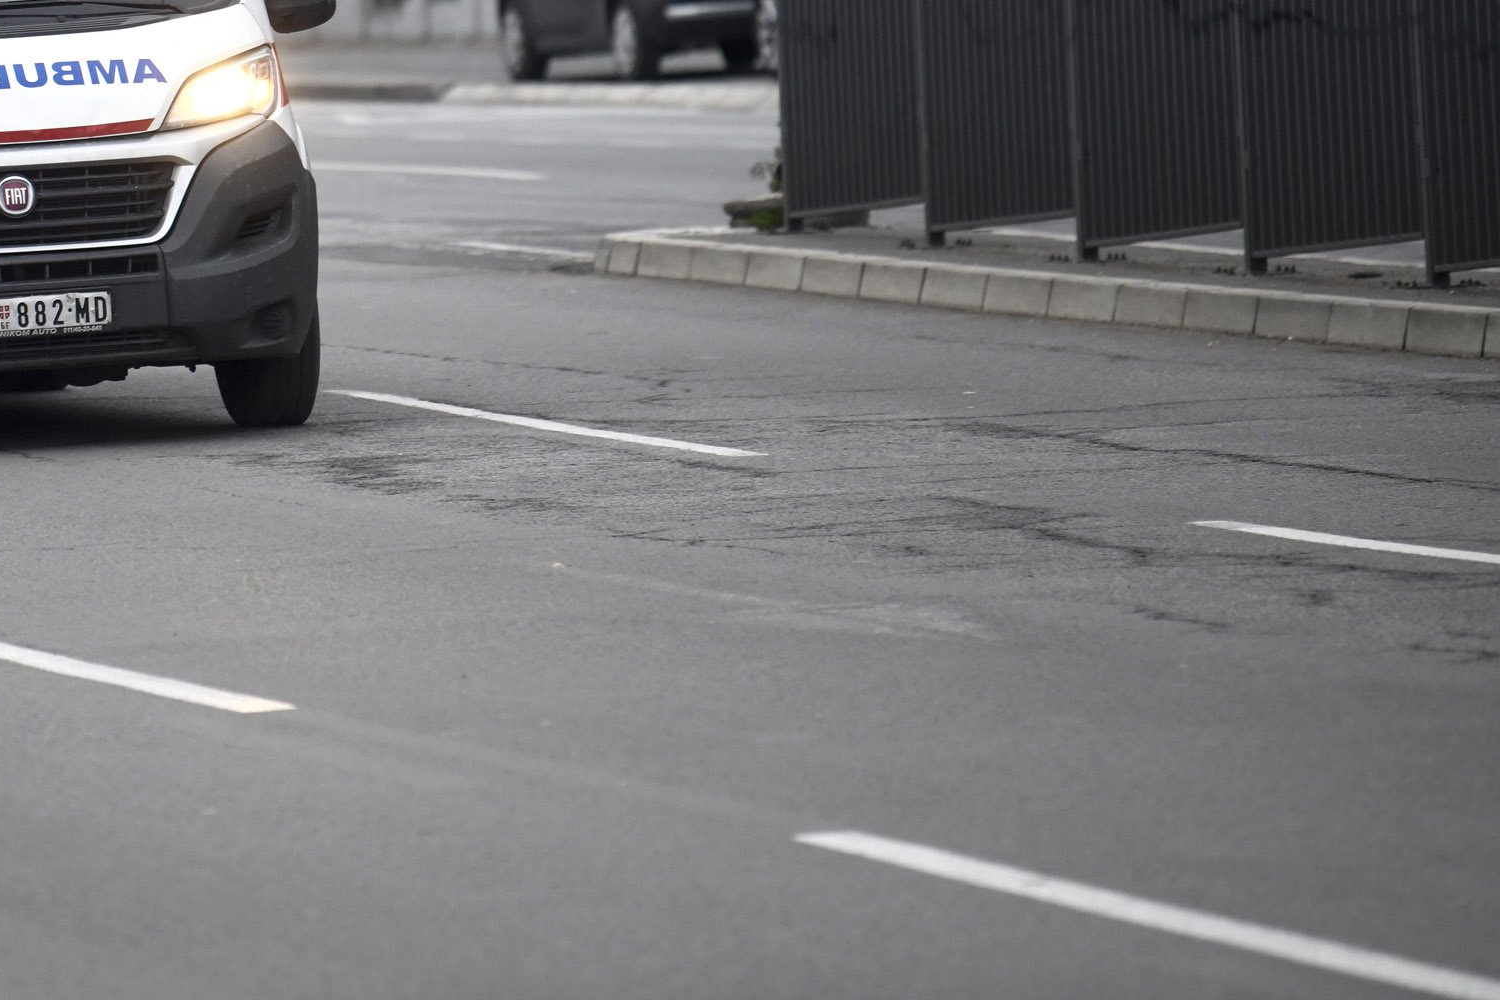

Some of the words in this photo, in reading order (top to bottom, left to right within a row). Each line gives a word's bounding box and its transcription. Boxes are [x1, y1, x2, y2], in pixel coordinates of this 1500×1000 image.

[4, 187, 27, 206] FIAT
[0, 329, 30, 338] NIKOM
[32, 327, 58, 336] AUTO
